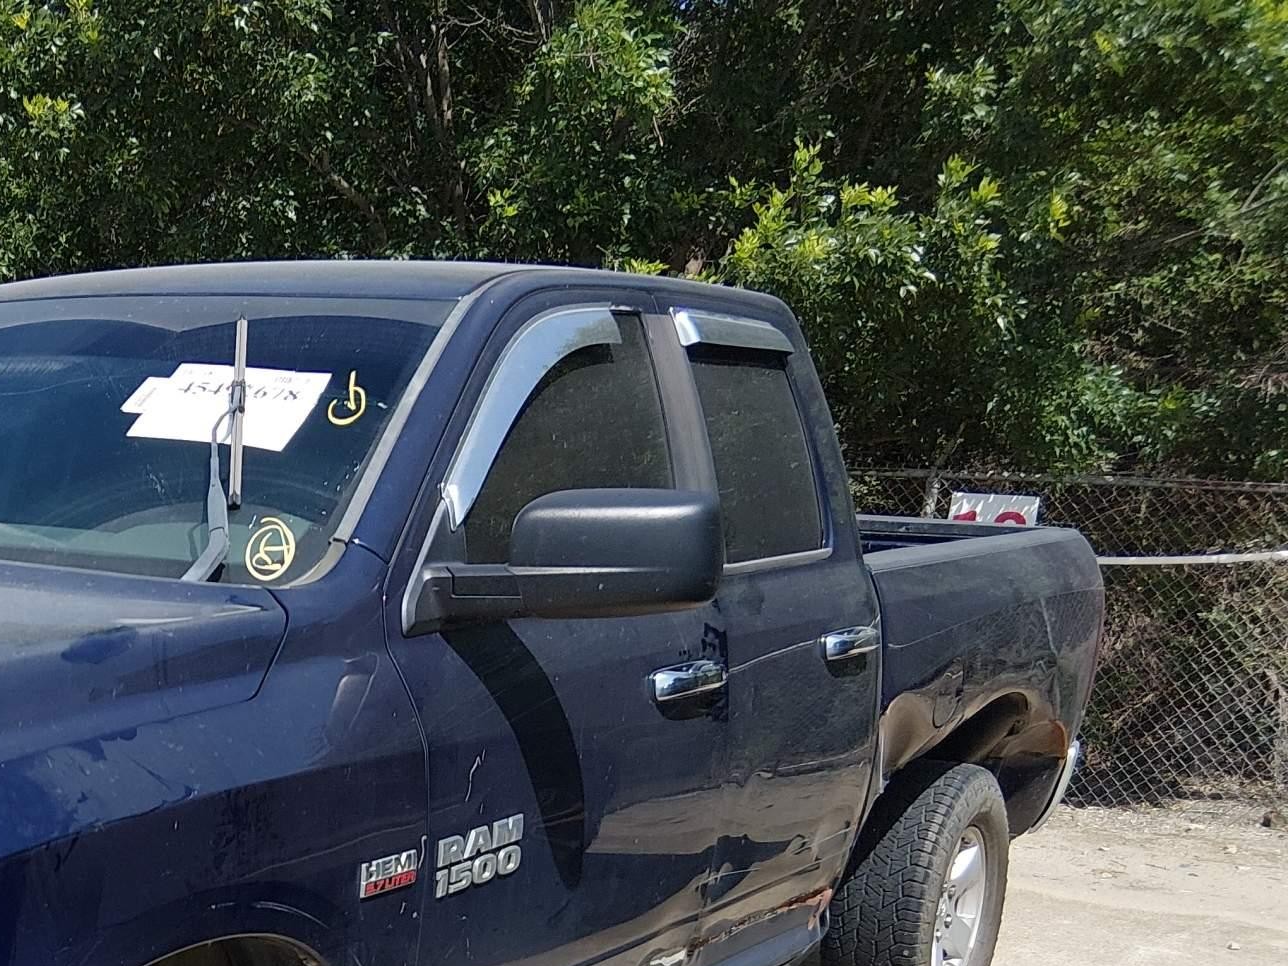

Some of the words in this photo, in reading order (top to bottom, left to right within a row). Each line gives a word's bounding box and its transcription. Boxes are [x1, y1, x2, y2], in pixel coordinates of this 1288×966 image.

[361, 849, 418, 882] HEMI
[437, 813, 524, 868] RAM
[435, 845, 522, 899] 1500
